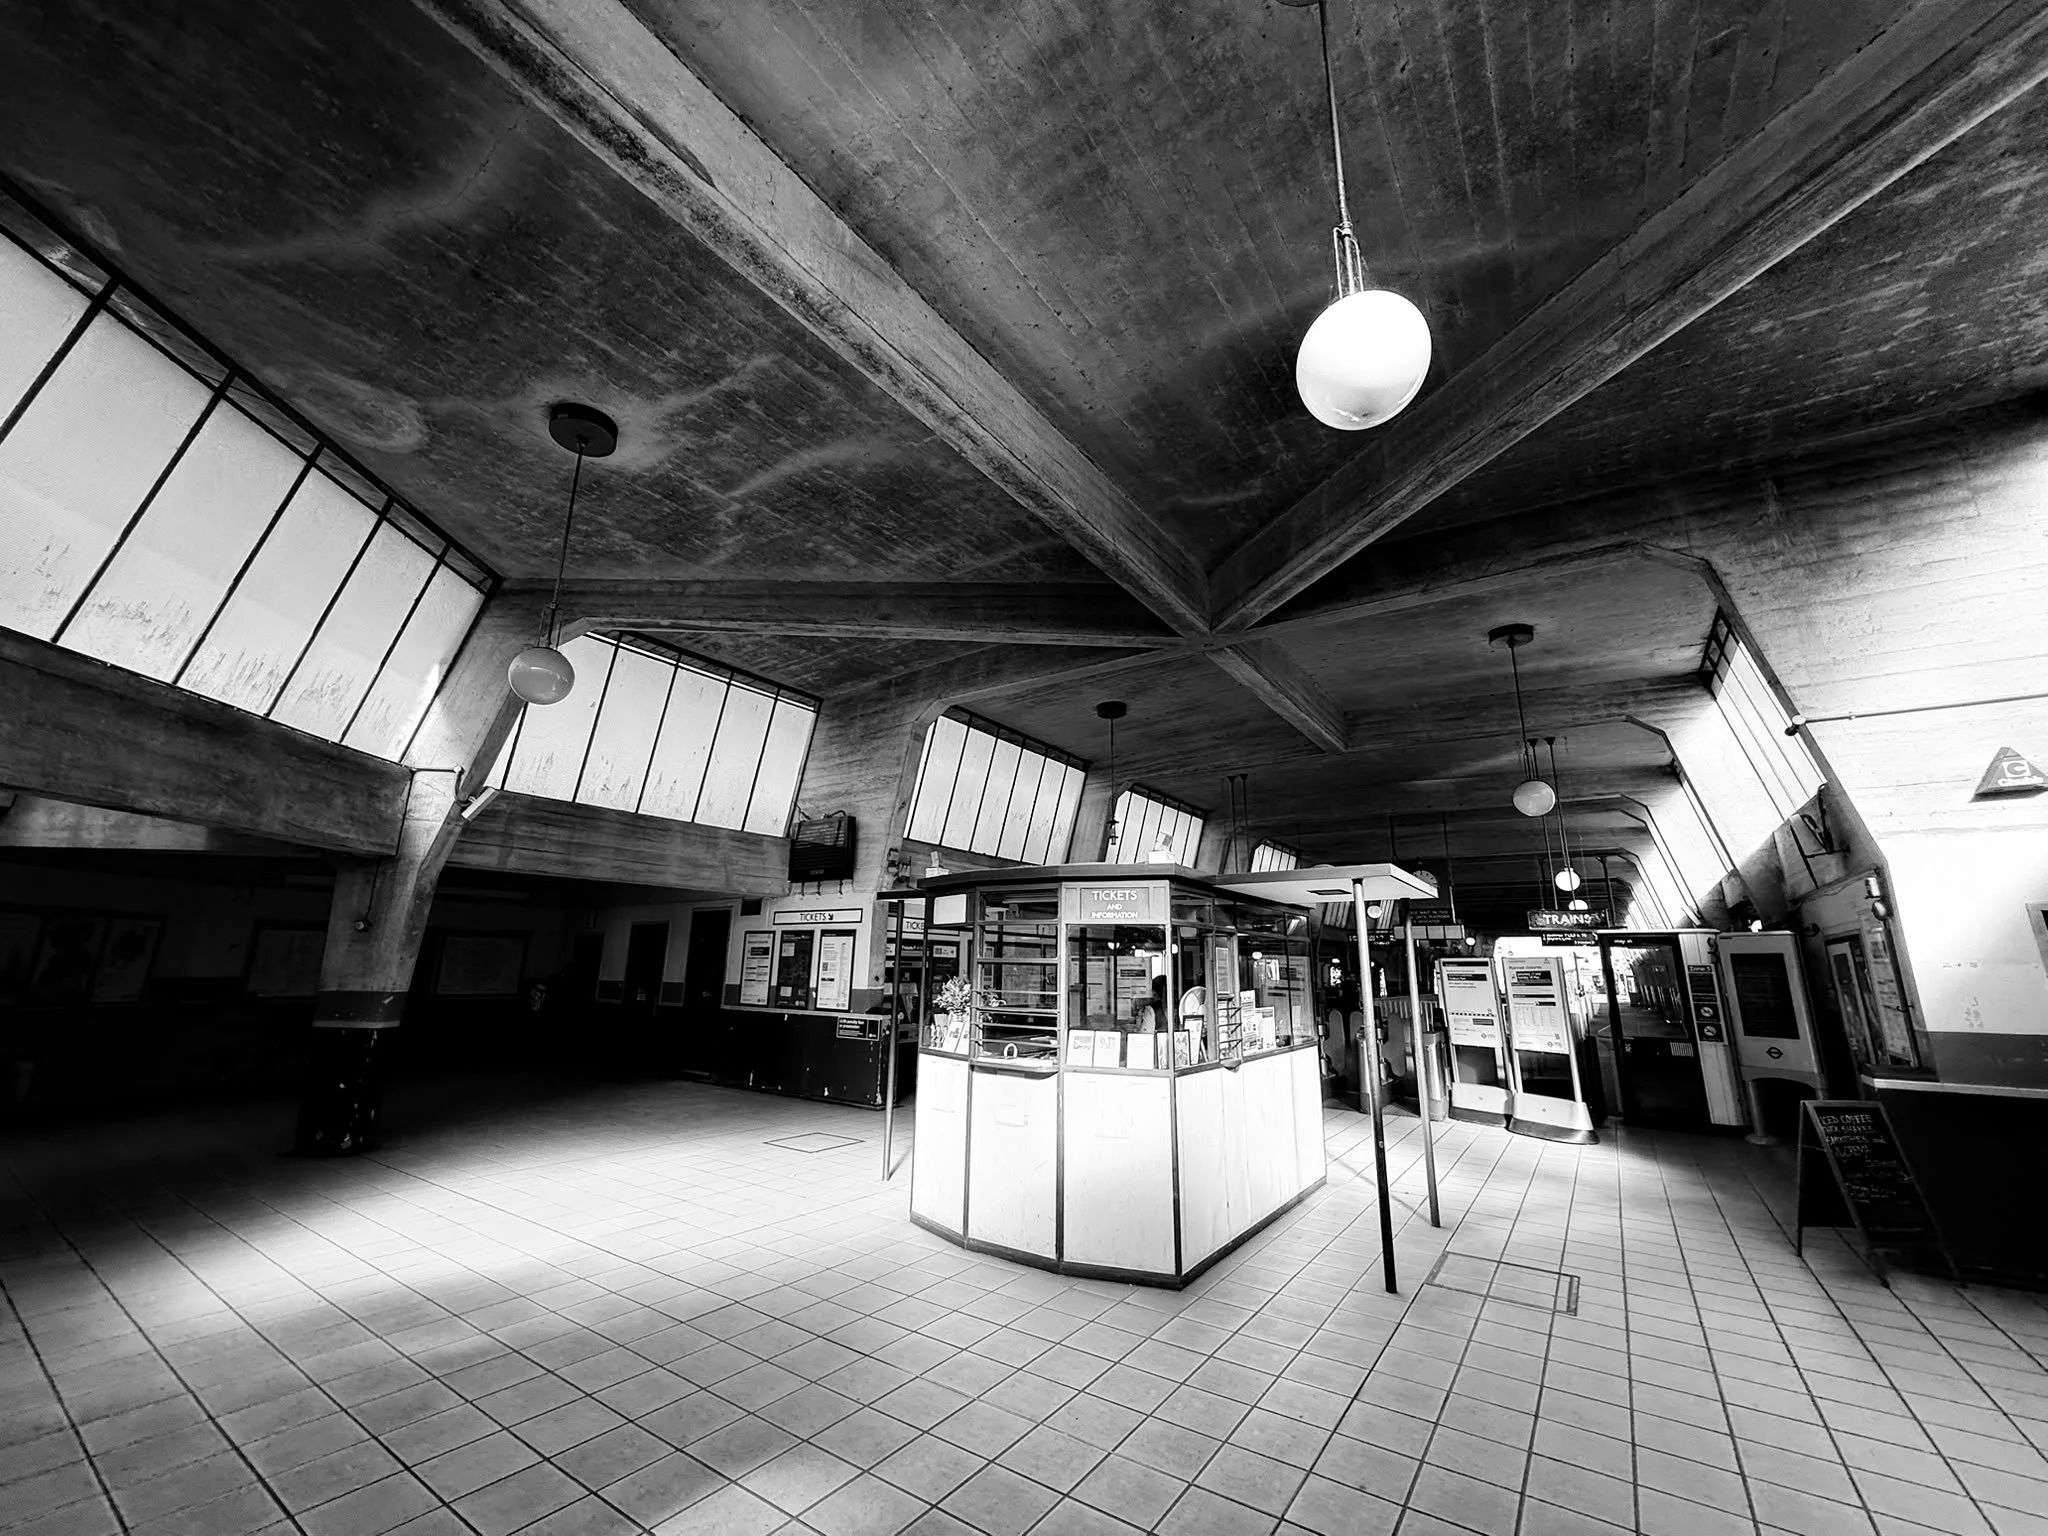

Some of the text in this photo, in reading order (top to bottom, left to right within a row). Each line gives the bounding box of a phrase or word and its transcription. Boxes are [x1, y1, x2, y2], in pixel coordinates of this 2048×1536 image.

[1092, 889, 1138, 901] TICKETS
[800, 912, 827, 921] TICKETS
[1091, 911, 1138, 919] INFORMATION
[1543, 913, 1592, 925] TRAINS
[905, 921, 925, 930] TICKE
[1840, 1114, 1873, 1124] COFFEE
